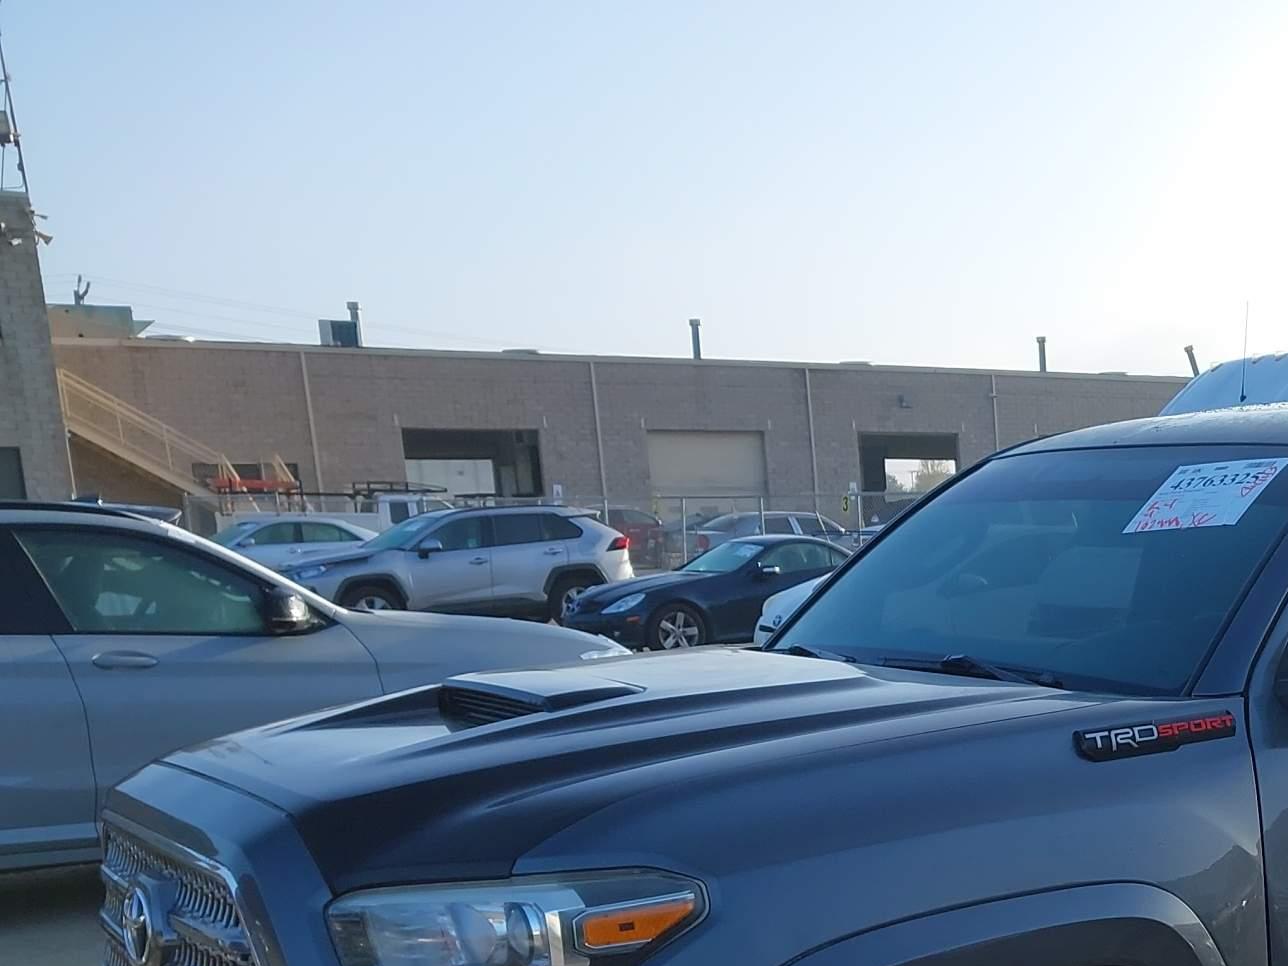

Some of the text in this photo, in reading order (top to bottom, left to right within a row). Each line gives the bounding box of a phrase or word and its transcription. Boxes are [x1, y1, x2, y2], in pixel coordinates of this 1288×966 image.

[1170, 472, 1262, 490] 43763325
[842, 496, 849, 512] 3
[1085, 715, 1233, 752] TRD SPORT
